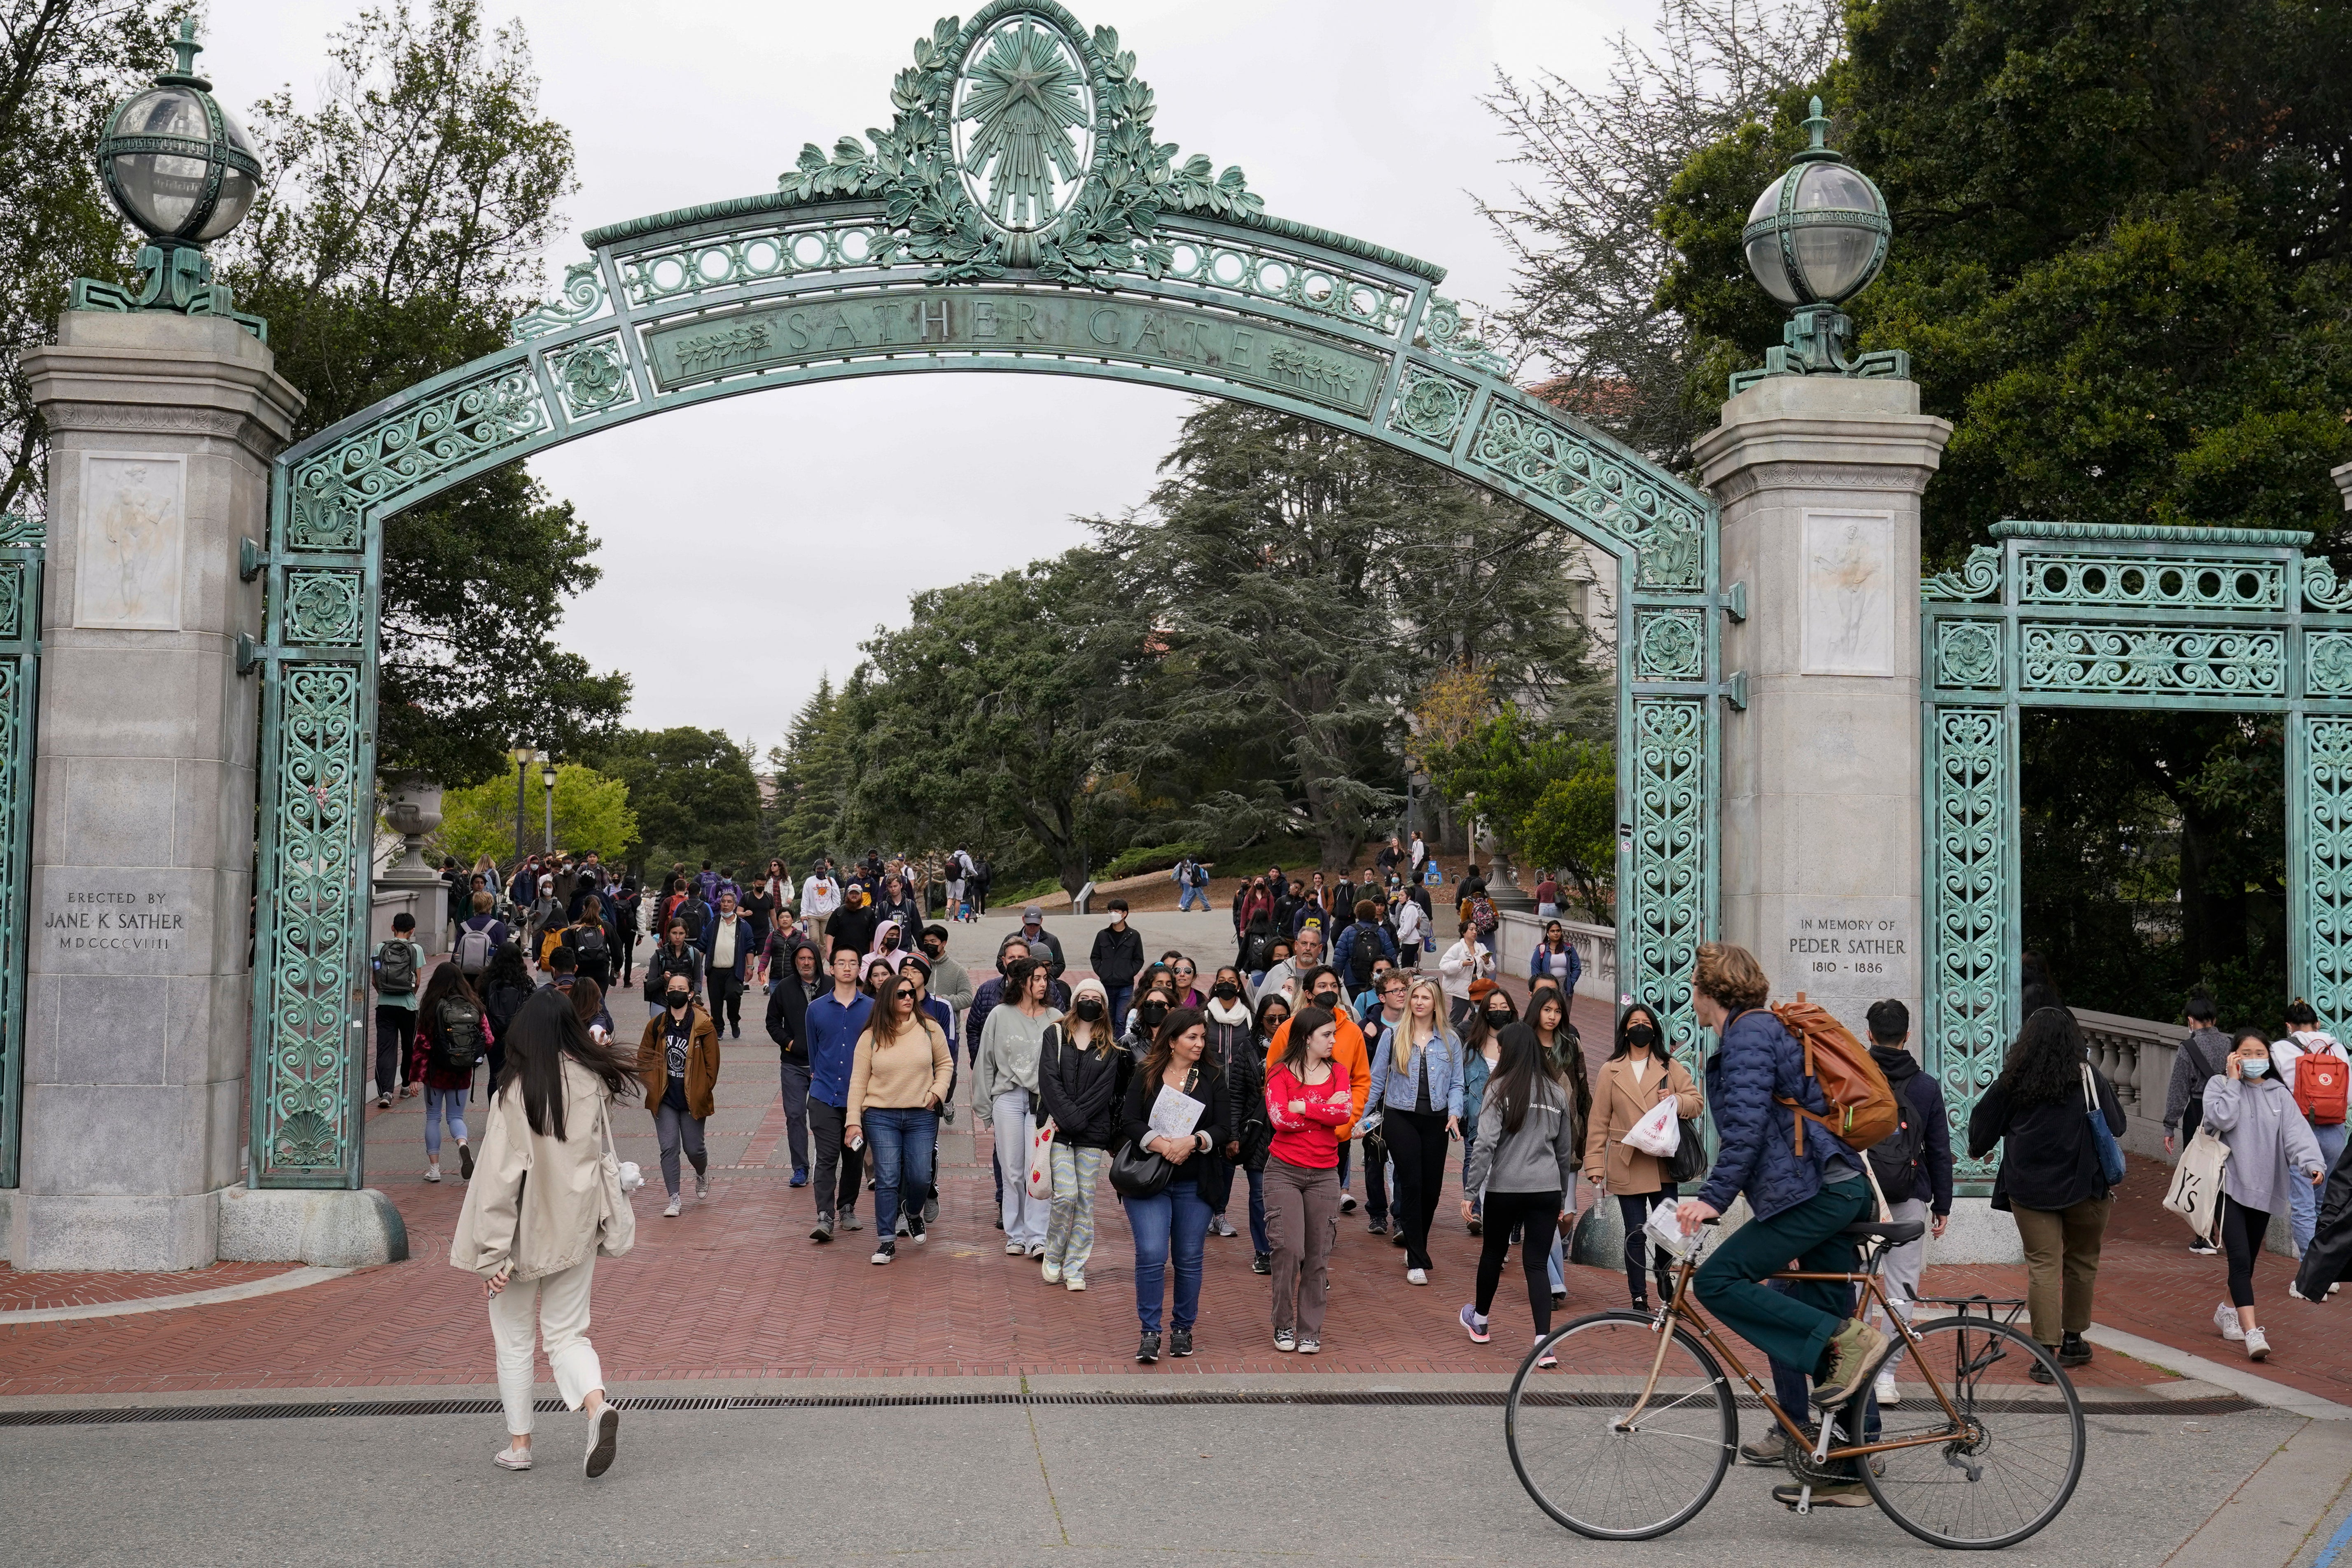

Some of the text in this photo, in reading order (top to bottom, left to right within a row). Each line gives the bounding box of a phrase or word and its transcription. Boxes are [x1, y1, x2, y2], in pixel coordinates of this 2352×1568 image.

[788, 301, 1254, 368] SATHER GATE
[68, 892, 166, 904] ERECTED BY
[45, 912, 184, 929] JANE K SATHER
[1801, 919, 1895, 931] IN MEMORY OF
[1790, 938, 1906, 954] PEDER SATHER
[1812, 962, 1836, 972] 1810
[1855, 963, 1883, 973] 1886
